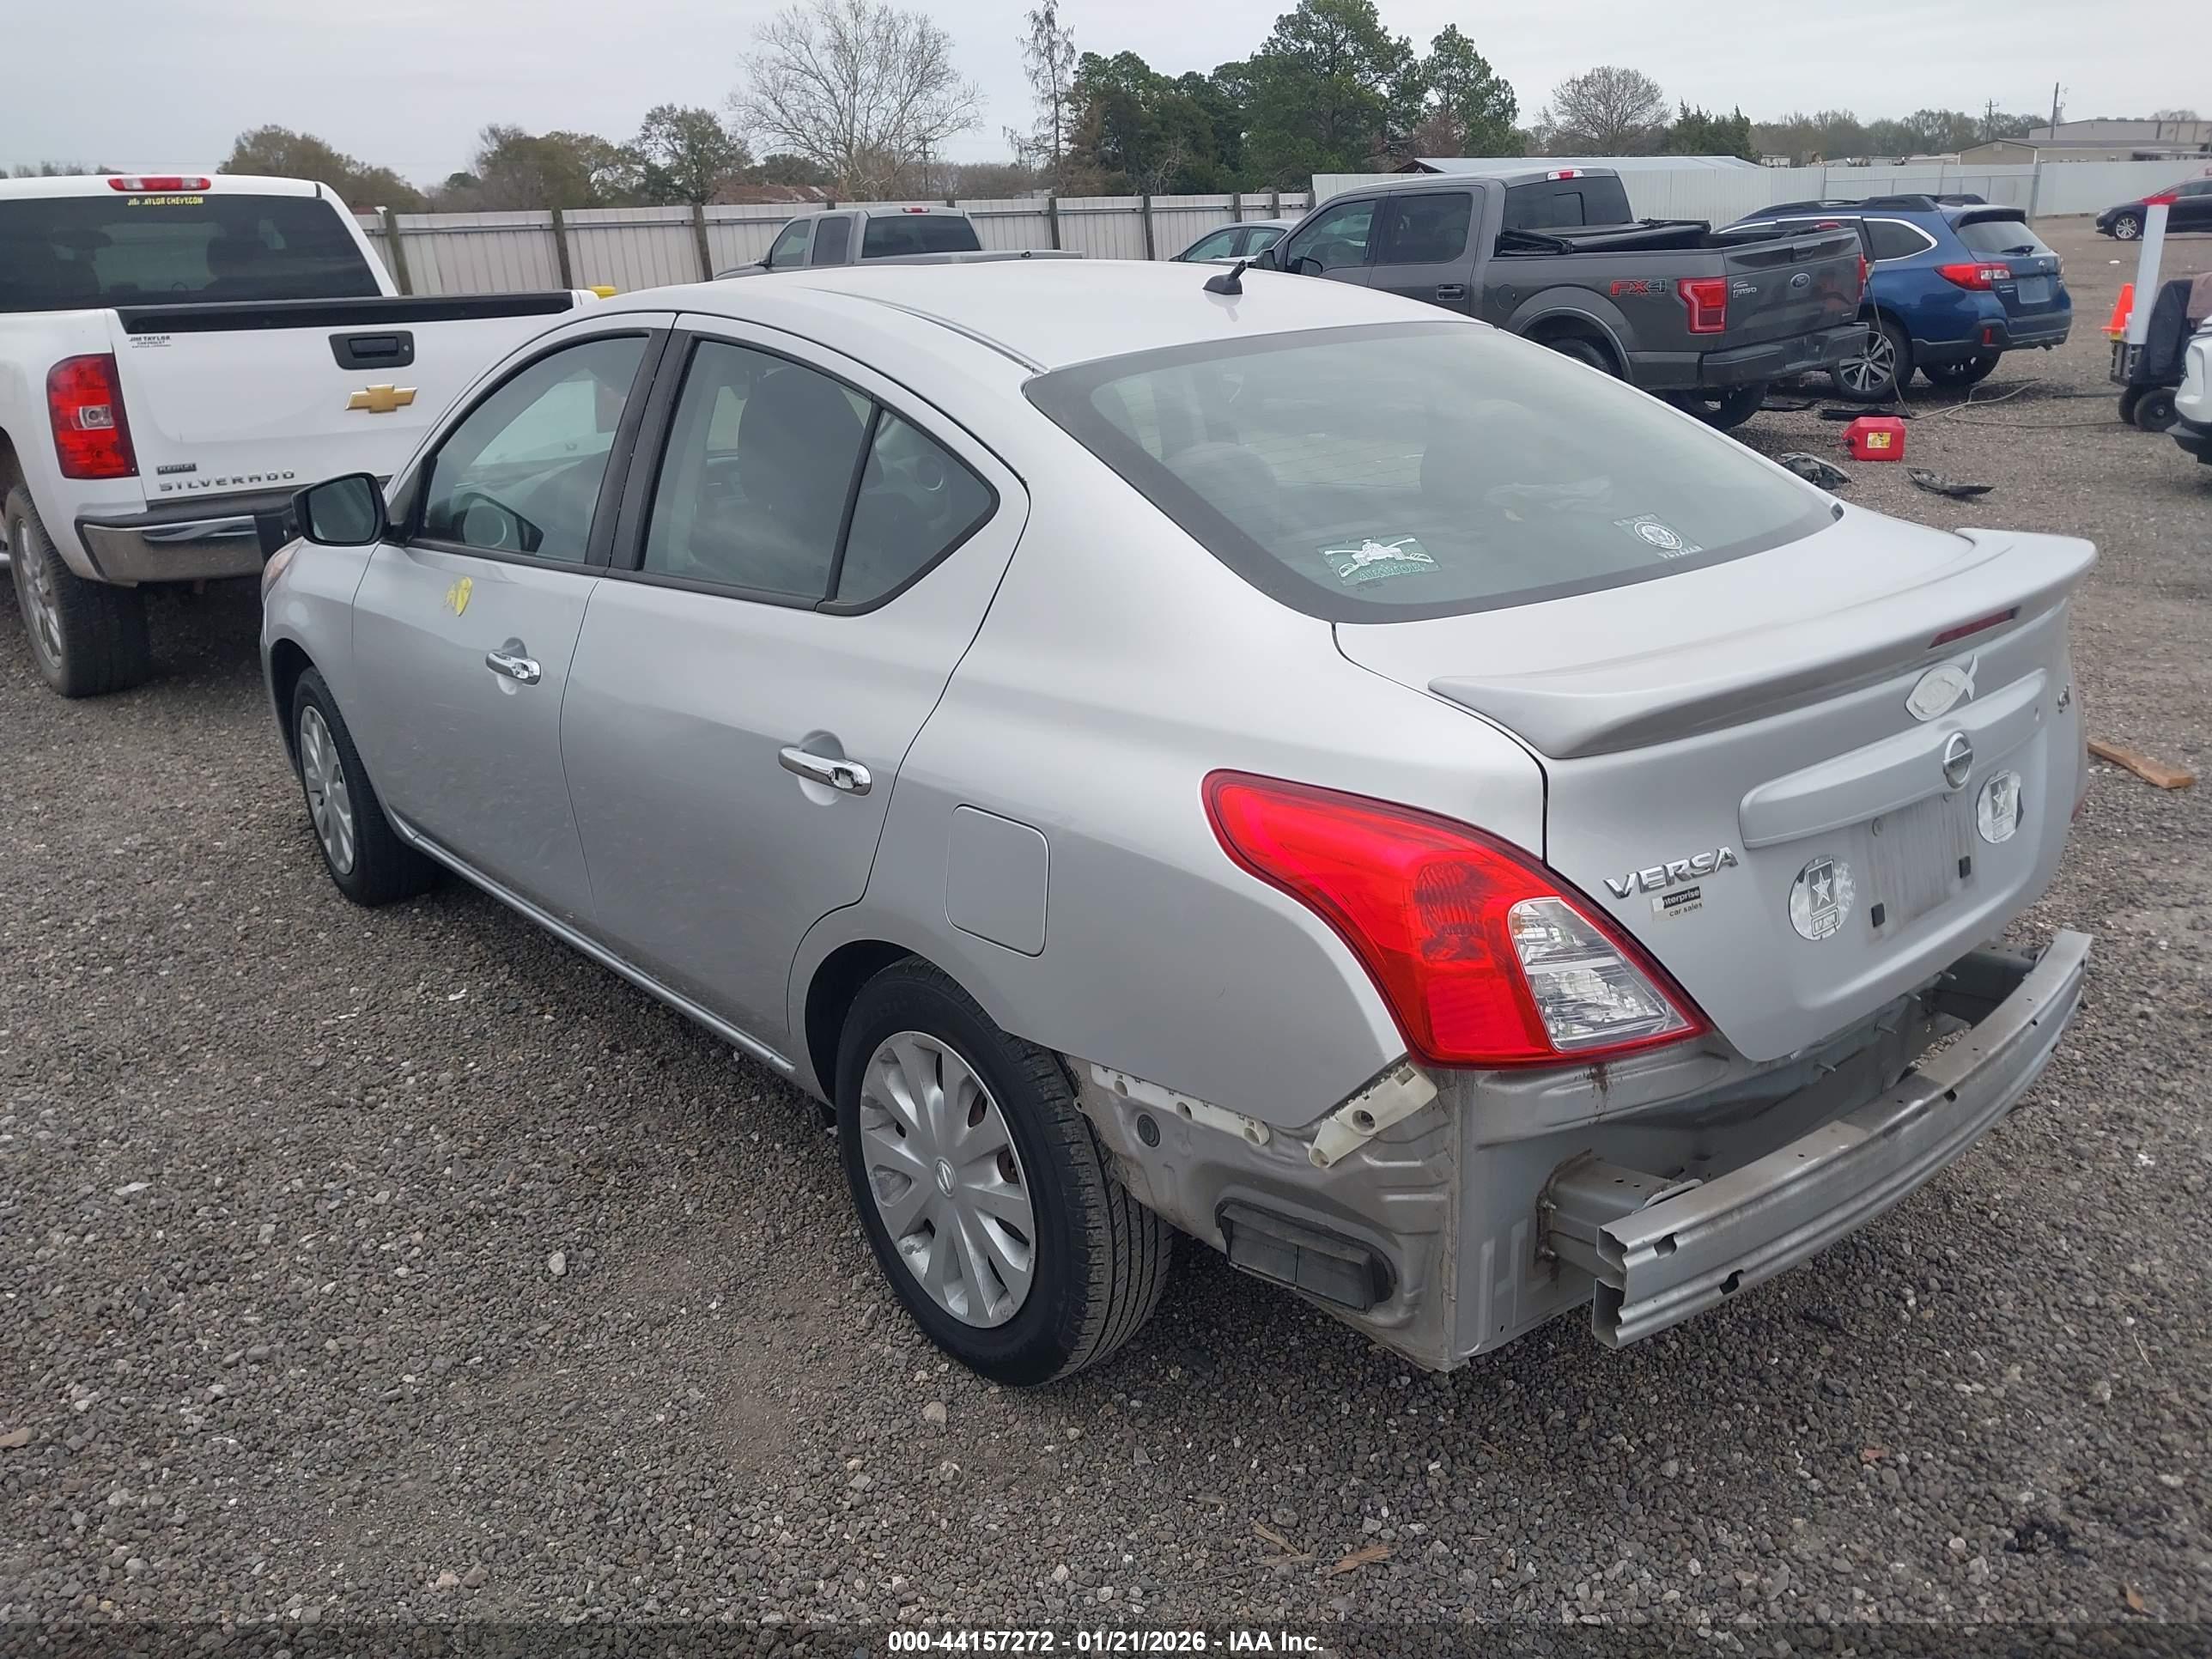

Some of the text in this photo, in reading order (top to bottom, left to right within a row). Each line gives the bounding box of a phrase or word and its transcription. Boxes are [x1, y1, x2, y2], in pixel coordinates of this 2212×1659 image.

[1610, 278, 1666, 296] FX4
[159, 470, 295, 492] SILVERADO
[1602, 846, 1739, 899] VERSA
[1663, 888, 1700, 908] nterprise
[1684, 902, 1703, 914] sales
